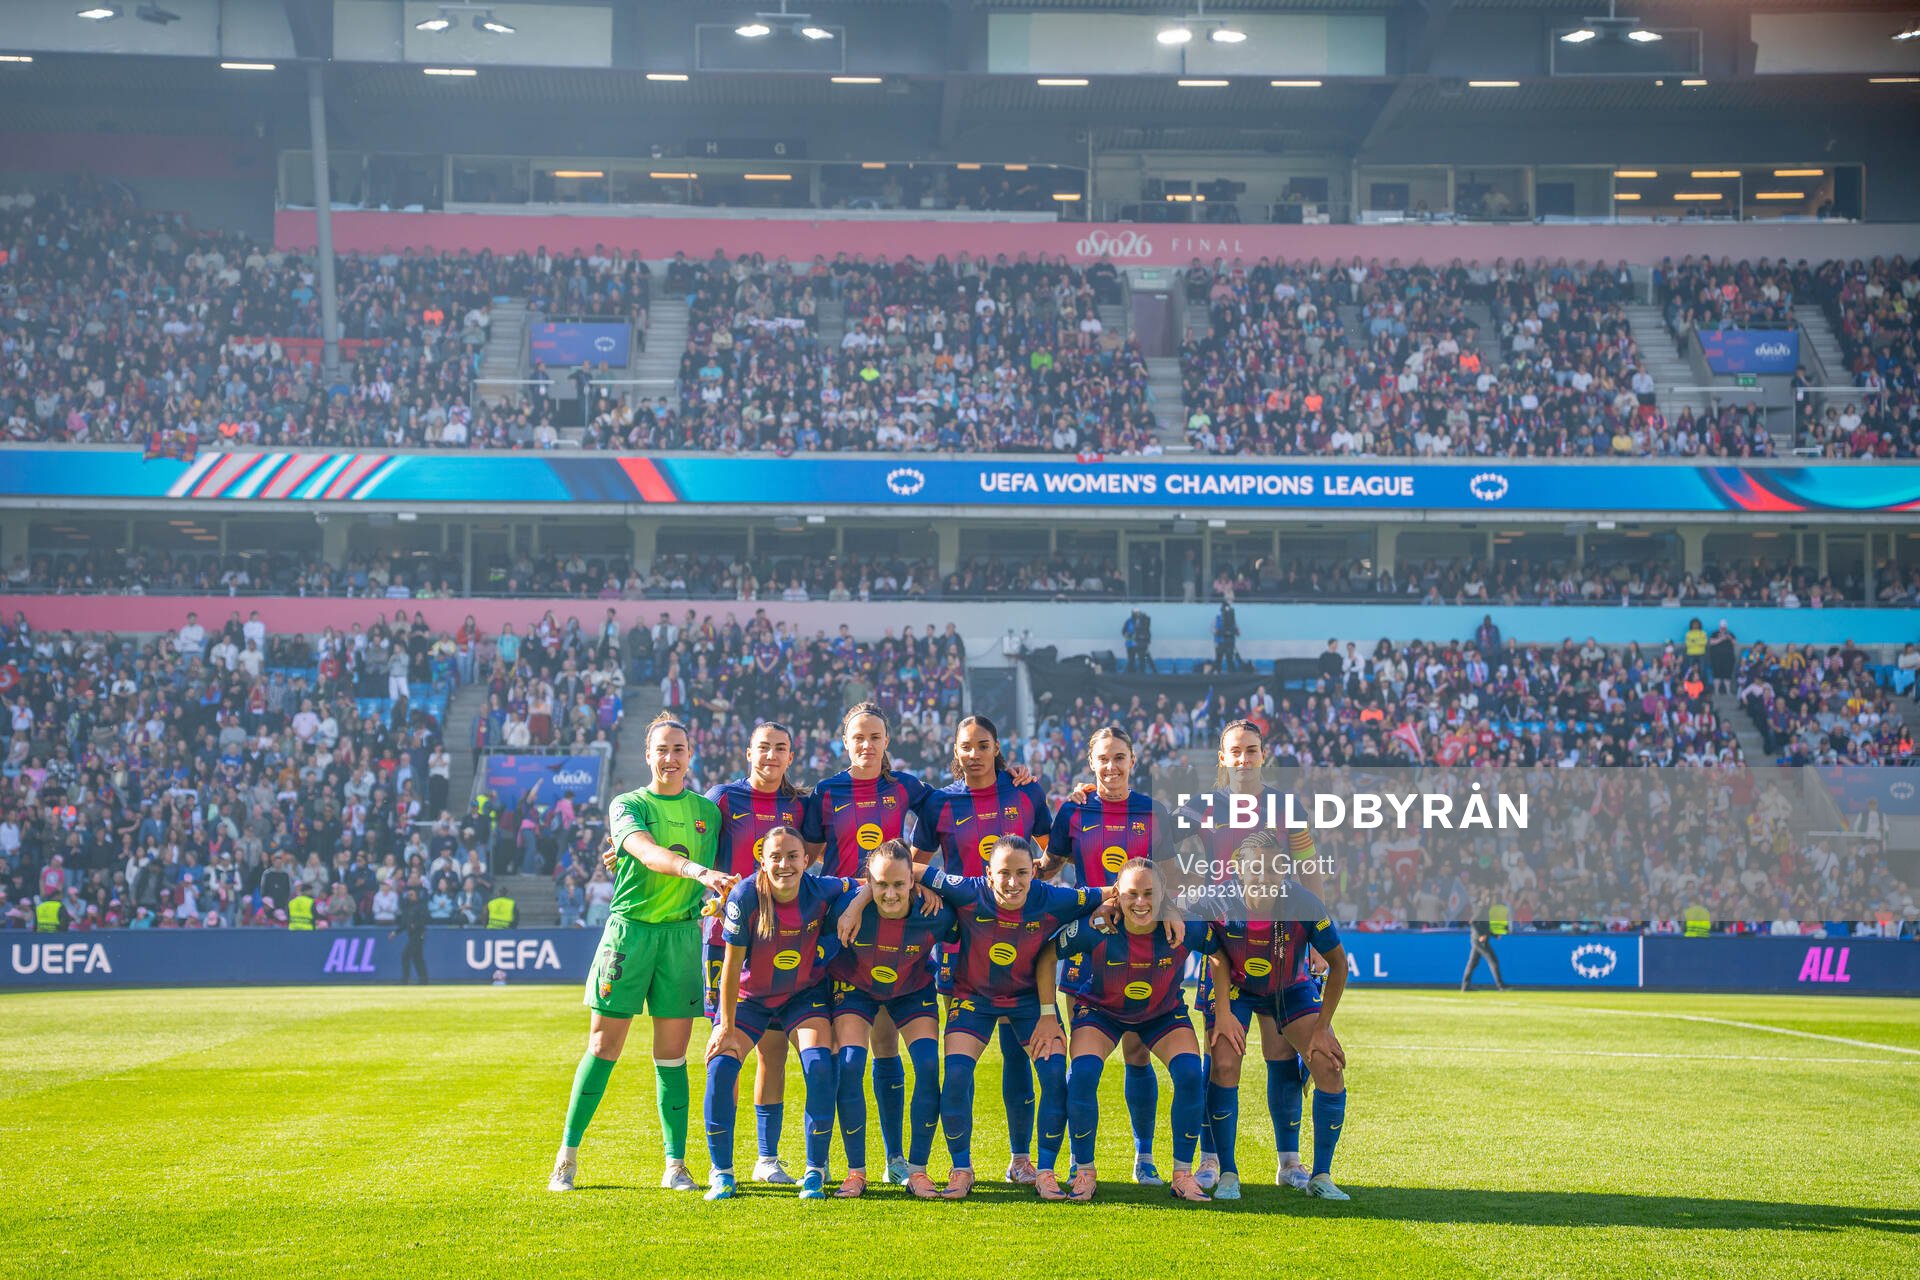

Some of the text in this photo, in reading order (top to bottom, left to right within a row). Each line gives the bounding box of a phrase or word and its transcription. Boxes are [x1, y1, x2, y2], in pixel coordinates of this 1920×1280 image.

[1171, 238, 1243, 253] FINAL
[980, 472, 1414, 496] UEFA WOMEN'S CHAMPIONS LEAGUE
[11, 943, 112, 974] UEFA
[323, 938, 376, 972] ALL
[466, 939, 561, 969] UEFA
[600, 949, 627, 981] 13
[1798, 946, 1851, 982] ALL
